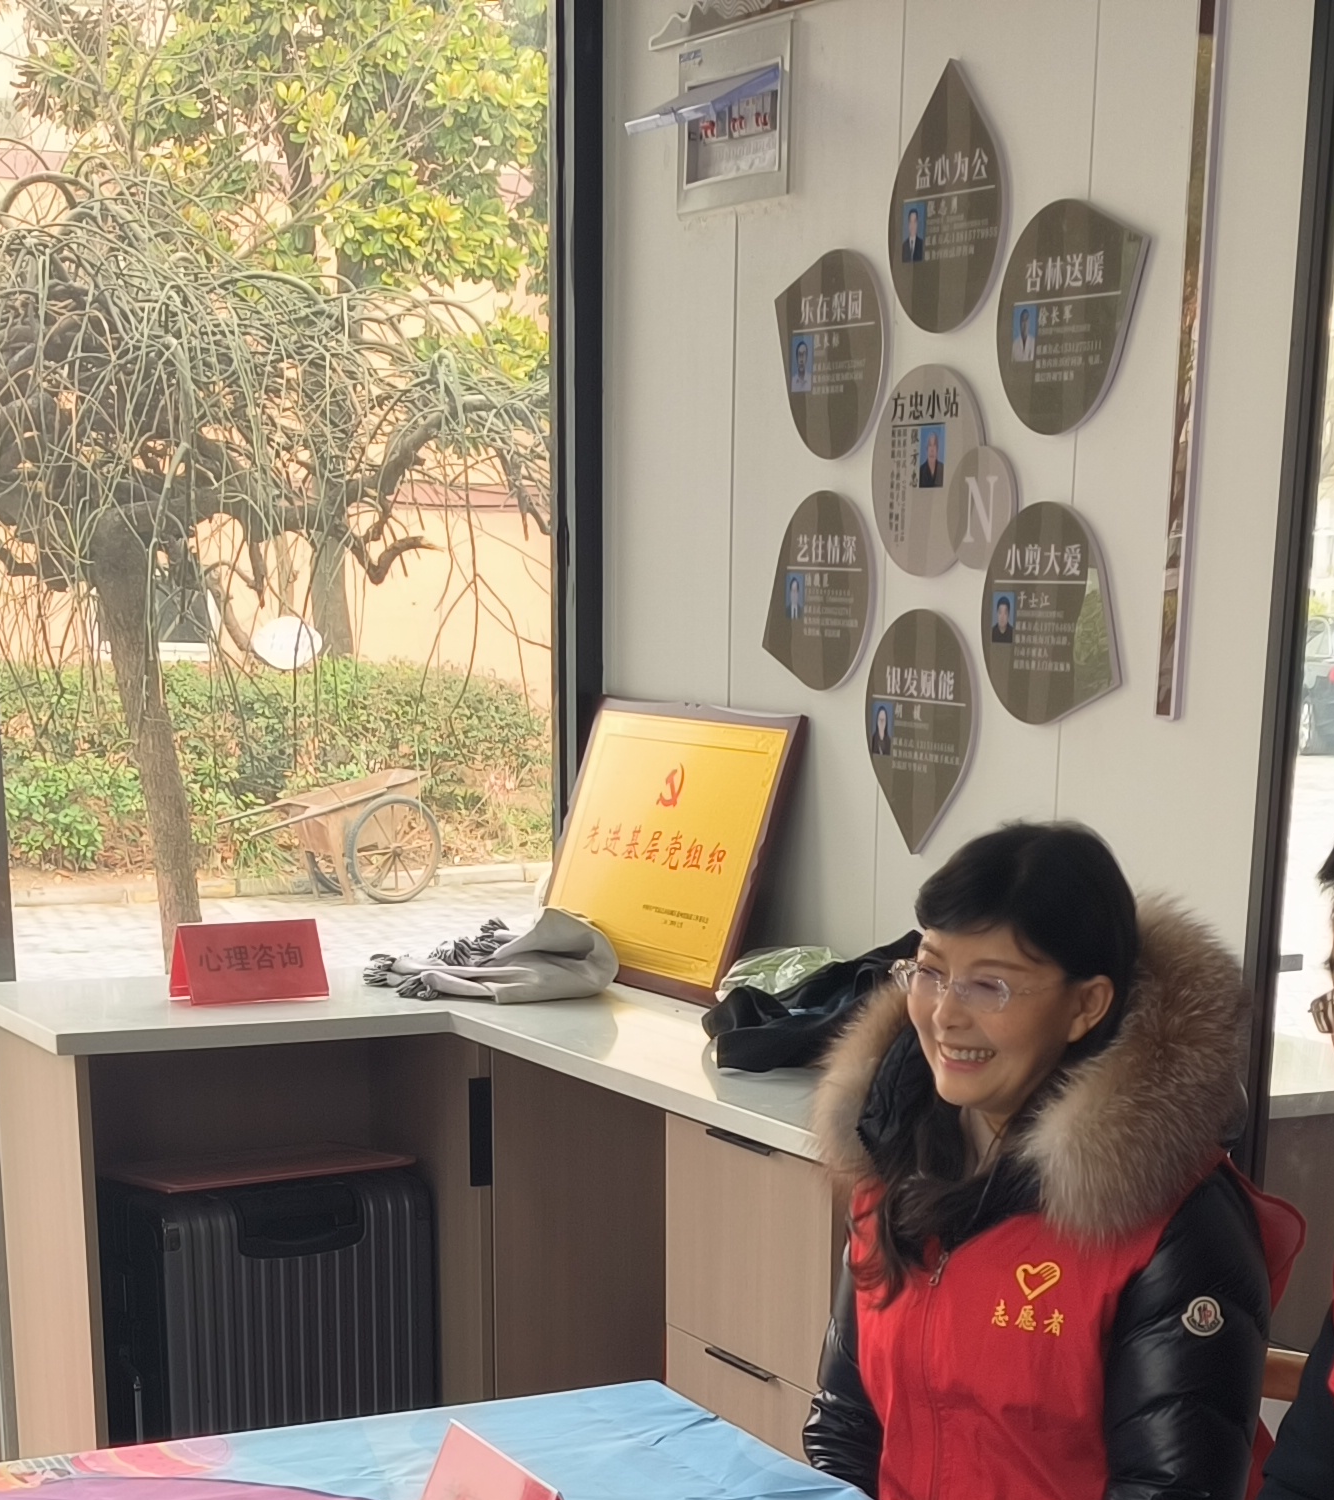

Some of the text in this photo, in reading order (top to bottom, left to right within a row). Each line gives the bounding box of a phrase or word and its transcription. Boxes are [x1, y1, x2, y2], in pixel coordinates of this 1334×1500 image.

[915, 147, 988, 190] 益心为公
[1025, 251, 1104, 293] 杏林送暖
[800, 290, 862, 325] 乐在梨园
[891, 386, 960, 423] 方忠小站
[963, 475, 999, 543] N
[796, 534, 857, 565] 艺往情深
[1004, 543, 1082, 577] 小剪大爱
[886, 665, 955, 701] 银发赋能
[583, 818, 727, 875] 先进基层党组织
[199, 942, 303, 972] 心理咨询
[991, 1300, 1064, 1336] 志愿者
